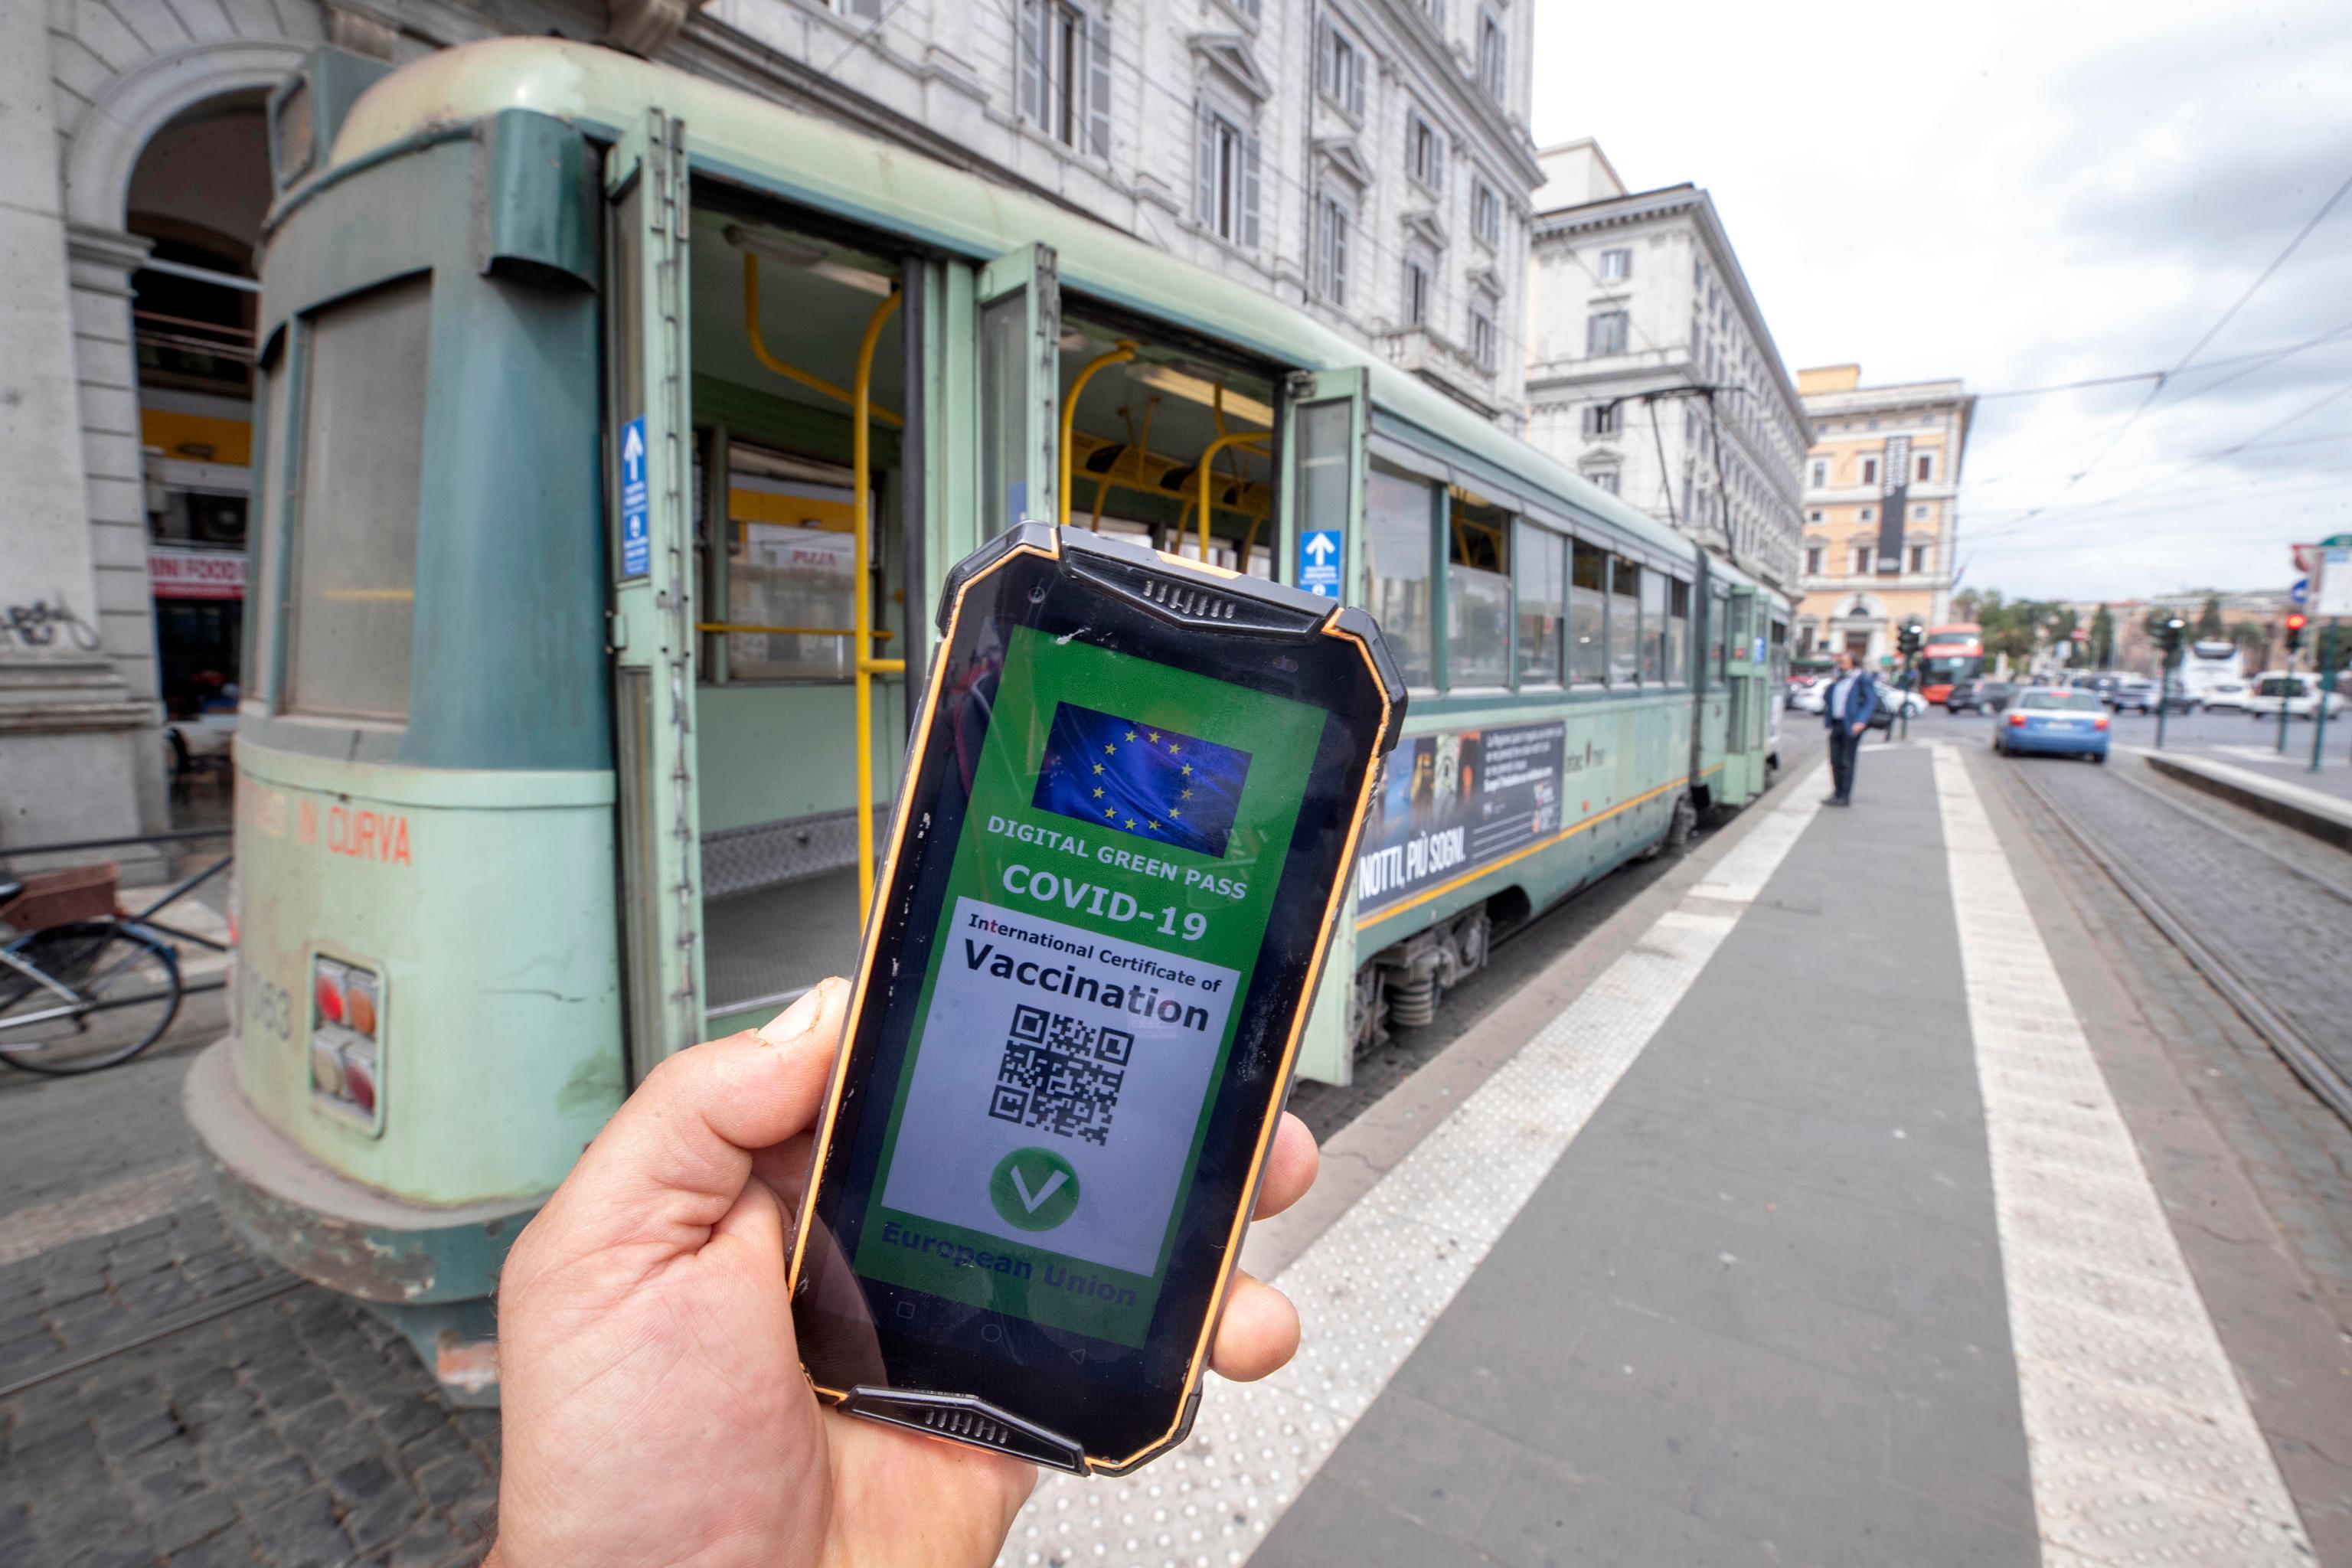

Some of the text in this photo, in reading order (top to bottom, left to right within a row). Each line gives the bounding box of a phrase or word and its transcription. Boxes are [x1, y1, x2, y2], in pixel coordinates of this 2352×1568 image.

[297, 799, 318, 845] IN
[327, 806, 411, 867] CURVA
[987, 815, 1248, 900] DIGITAL GREEN PASS
[1358, 825, 1466, 900] NOTTI, PIÙ SOGNI.
[1002, 864, 1208, 942] COVID-19
[964, 938, 1210, 1032] Vaccination
[968, 913, 1223, 993] International Certificate of
[880, 1220, 1137, 1306] European Union
